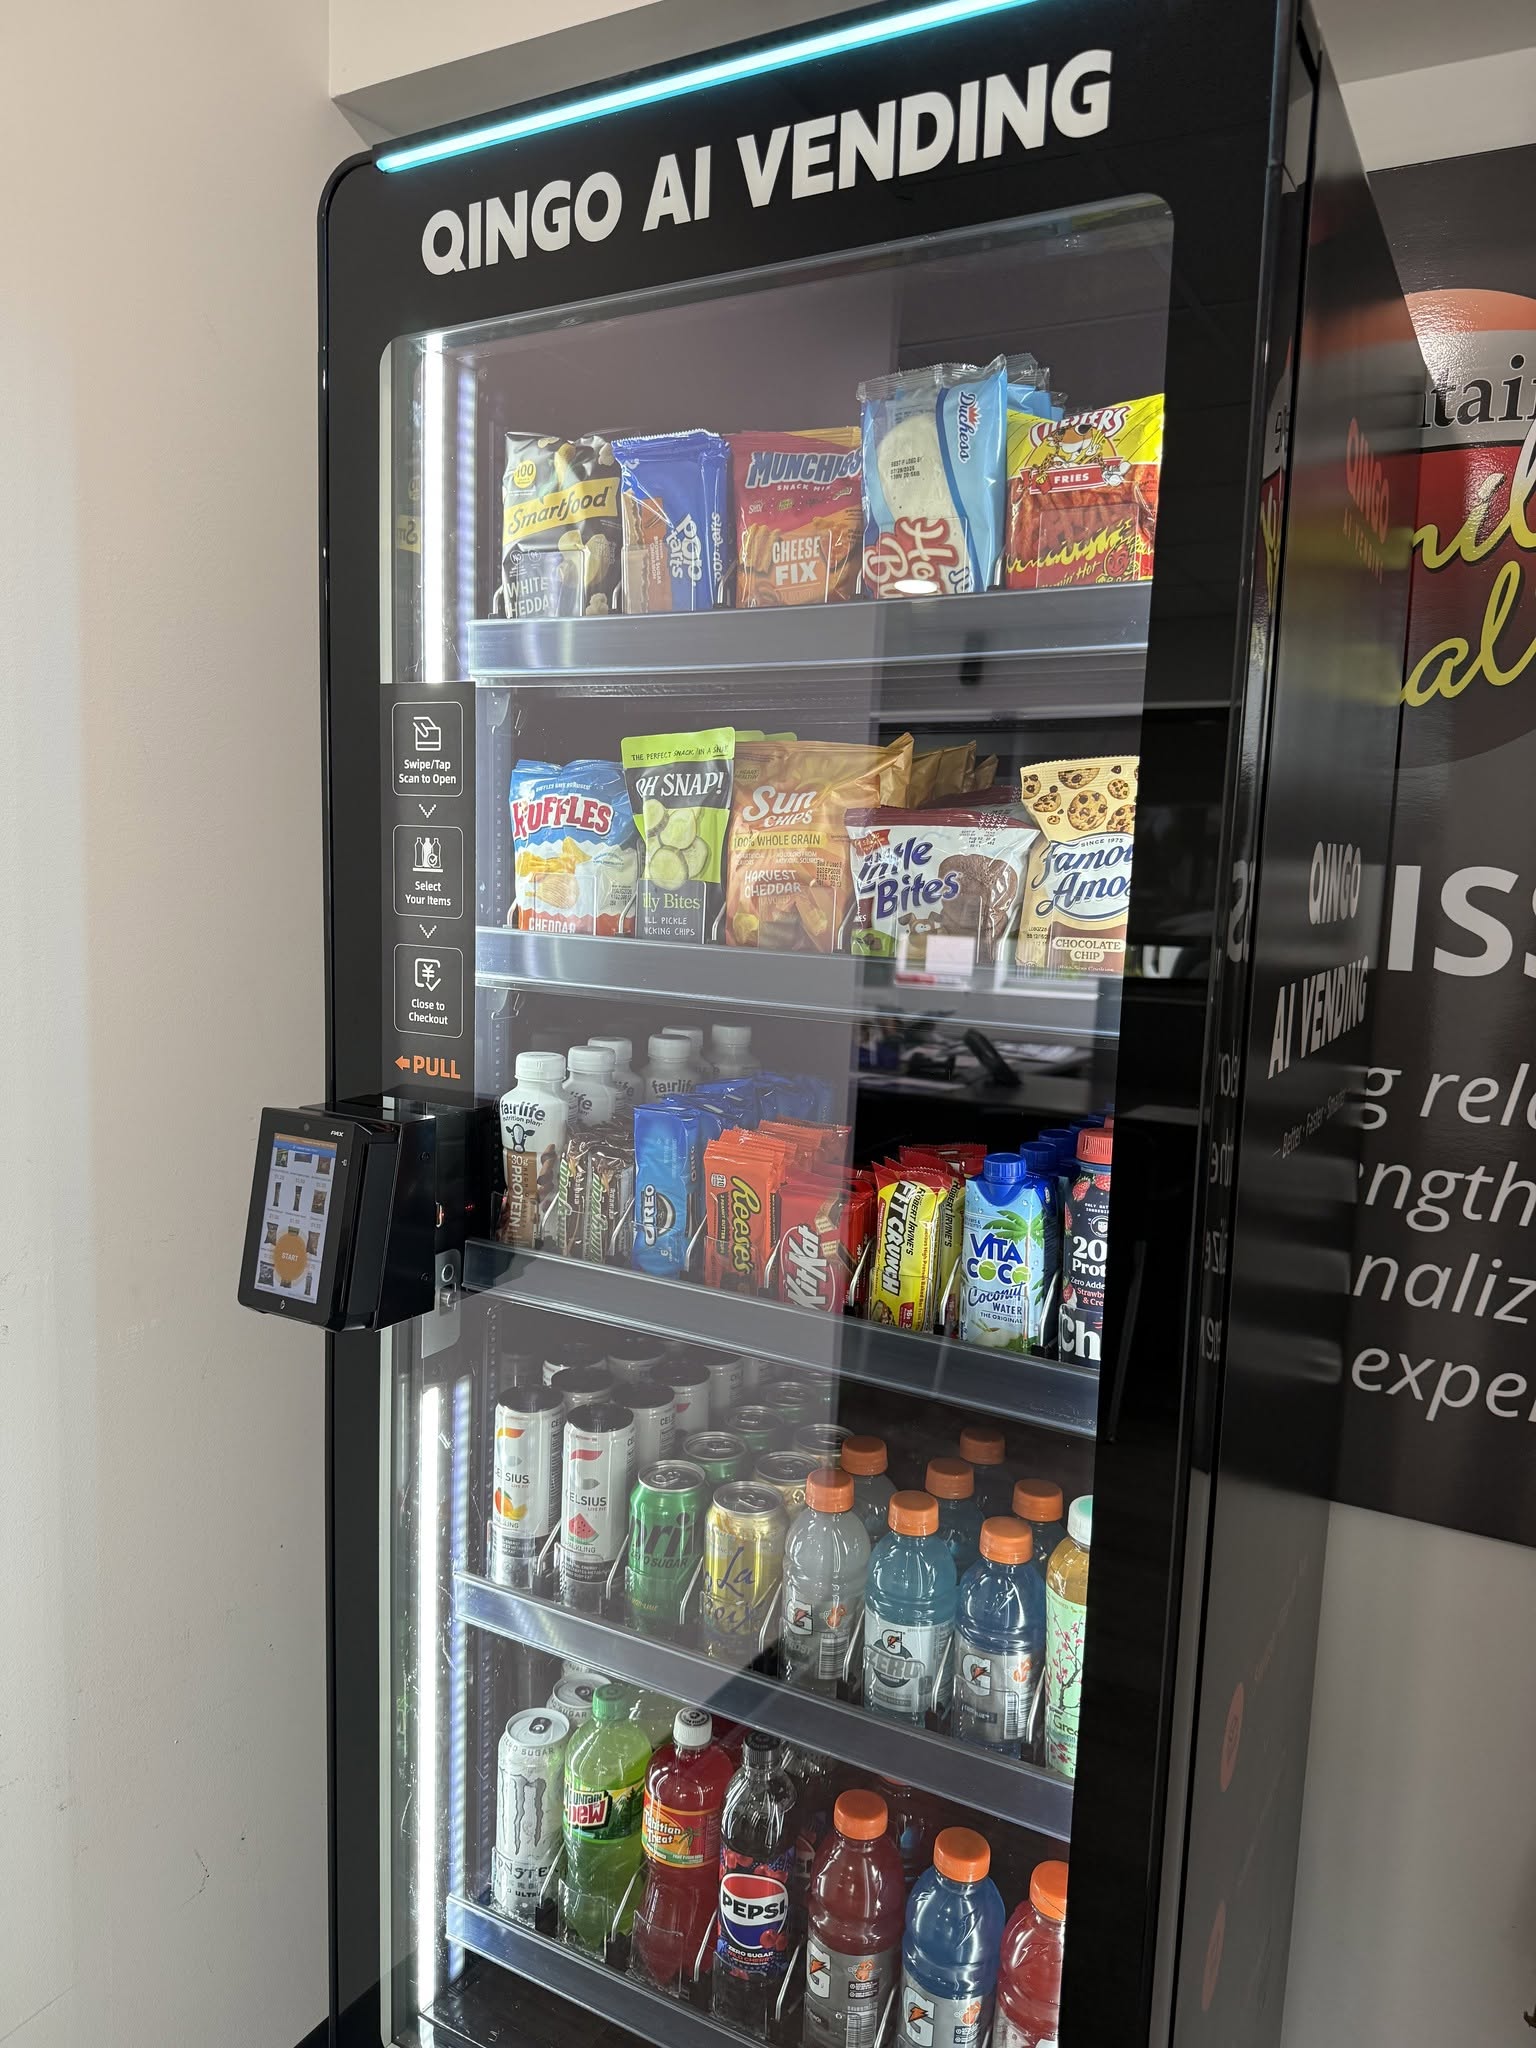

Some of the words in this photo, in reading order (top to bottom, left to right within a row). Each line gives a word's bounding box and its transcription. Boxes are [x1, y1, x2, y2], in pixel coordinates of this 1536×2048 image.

[420, 171, 623, 277] QINGO
[643, 145, 713, 232] AI
[736, 48, 1113, 209] VENDING
[1420, 353, 1536, 428] tai
[957, 391, 976, 464] Duchess
[776, 483, 809, 491] SNACK
[1054, 472, 1090, 485] FRIES
[1346, 416, 1389, 544] QINGO
[508, 486, 610, 535] Smartfood
[773, 536, 821, 564] CHEESE
[775, 560, 818, 586] FIX
[507, 576, 549, 598] WHITE
[508, 594, 550, 618] HEDDA
[404, 759, 451, 772] Swipe/Tap
[631, 754, 644, 762] THE
[646, 751, 672, 761] PERFECT
[399, 773, 420, 784] Scan
[422, 774, 431, 784] to
[433, 774, 457, 786] Open
[660, 772, 724, 797] SNAP!
[512, 796, 613, 838] RUFFLES
[763, 809, 813, 828] CHIPS
[757, 834, 791, 847] WHOLE
[792, 834, 820, 845] GRAIN
[1080, 838, 1105, 848] SINCE
[1107, 837, 1125, 845] 1975
[414, 880, 442, 892] Select
[745, 869, 797, 884] HARVEST
[1309, 840, 1361, 925] QINGO
[744, 882, 801, 898] CHEDDAR
[876, 871, 961, 919] Bites
[405, 894, 425, 905] Your
[427, 895, 451, 906] Items
[664, 893, 701, 910] Bites
[661, 916, 687, 926] PICKLE
[674, 926, 696, 936] CHIPS
[1056, 939, 1121, 950] CHOCOLATE
[1074, 951, 1100, 960] CHIP
[412, 998, 434, 1010] Close
[436, 1001, 445, 1011] to
[408, 1011, 448, 1025] Checkout
[1267, 982, 1296, 1080] AI
[1301, 955, 1369, 1058] VENDING
[413, 1055, 461, 1079] PULL
[716, 1174, 726, 1188] 210
[509, 1165, 523, 1229] PROTEIN
[908, 1186, 926, 1222] ROBERT
[1359, 1160, 1536, 1233] ngth
[643, 1184, 657, 1247] OREO
[731, 1176, 762, 1275] Reese's
[944, 1212, 957, 1248] IRVINE'S
[906, 1220, 919, 1256] IRVINE'S
[281, 1252, 299, 1262] START
[970, 1232, 1023, 1265] VITA
[920, 1260, 928, 1280] Protein
[967, 1257, 1032, 1285] COCO
[1072, 1257, 1106, 1277] Prot
[1070, 1275, 1085, 1286] Zero
[1085, 1279, 1106, 1290] Adde
[968, 1281, 1026, 1307] Coconut
[1082, 1296, 1089, 1304] &
[1090, 1297, 1104, 1307] Cre
[980, 1311, 992, 1319] THE
[992, 1312, 1023, 1324] ORIGINAL
[992, 1302, 1023, 1315] WATER
[1062, 1314, 1101, 1361] Ch
[1351, 1347, 1536, 1422] expe
[660, 1416, 675, 1427] CELS
[566, 1489, 607, 1508] ELSIUS
[651, 1556, 689, 1569] SUGAR
[717, 1546, 756, 1598] La
[558, 1708, 587, 1719] SUGAR
[521, 1747, 555, 1757] SUGAR
[645, 1811, 682, 1836] Tahitian
[647, 1830, 675, 1845] Treat
[722, 1890, 786, 1920] PEPSI
[728, 1944, 747, 1957] ZERO
